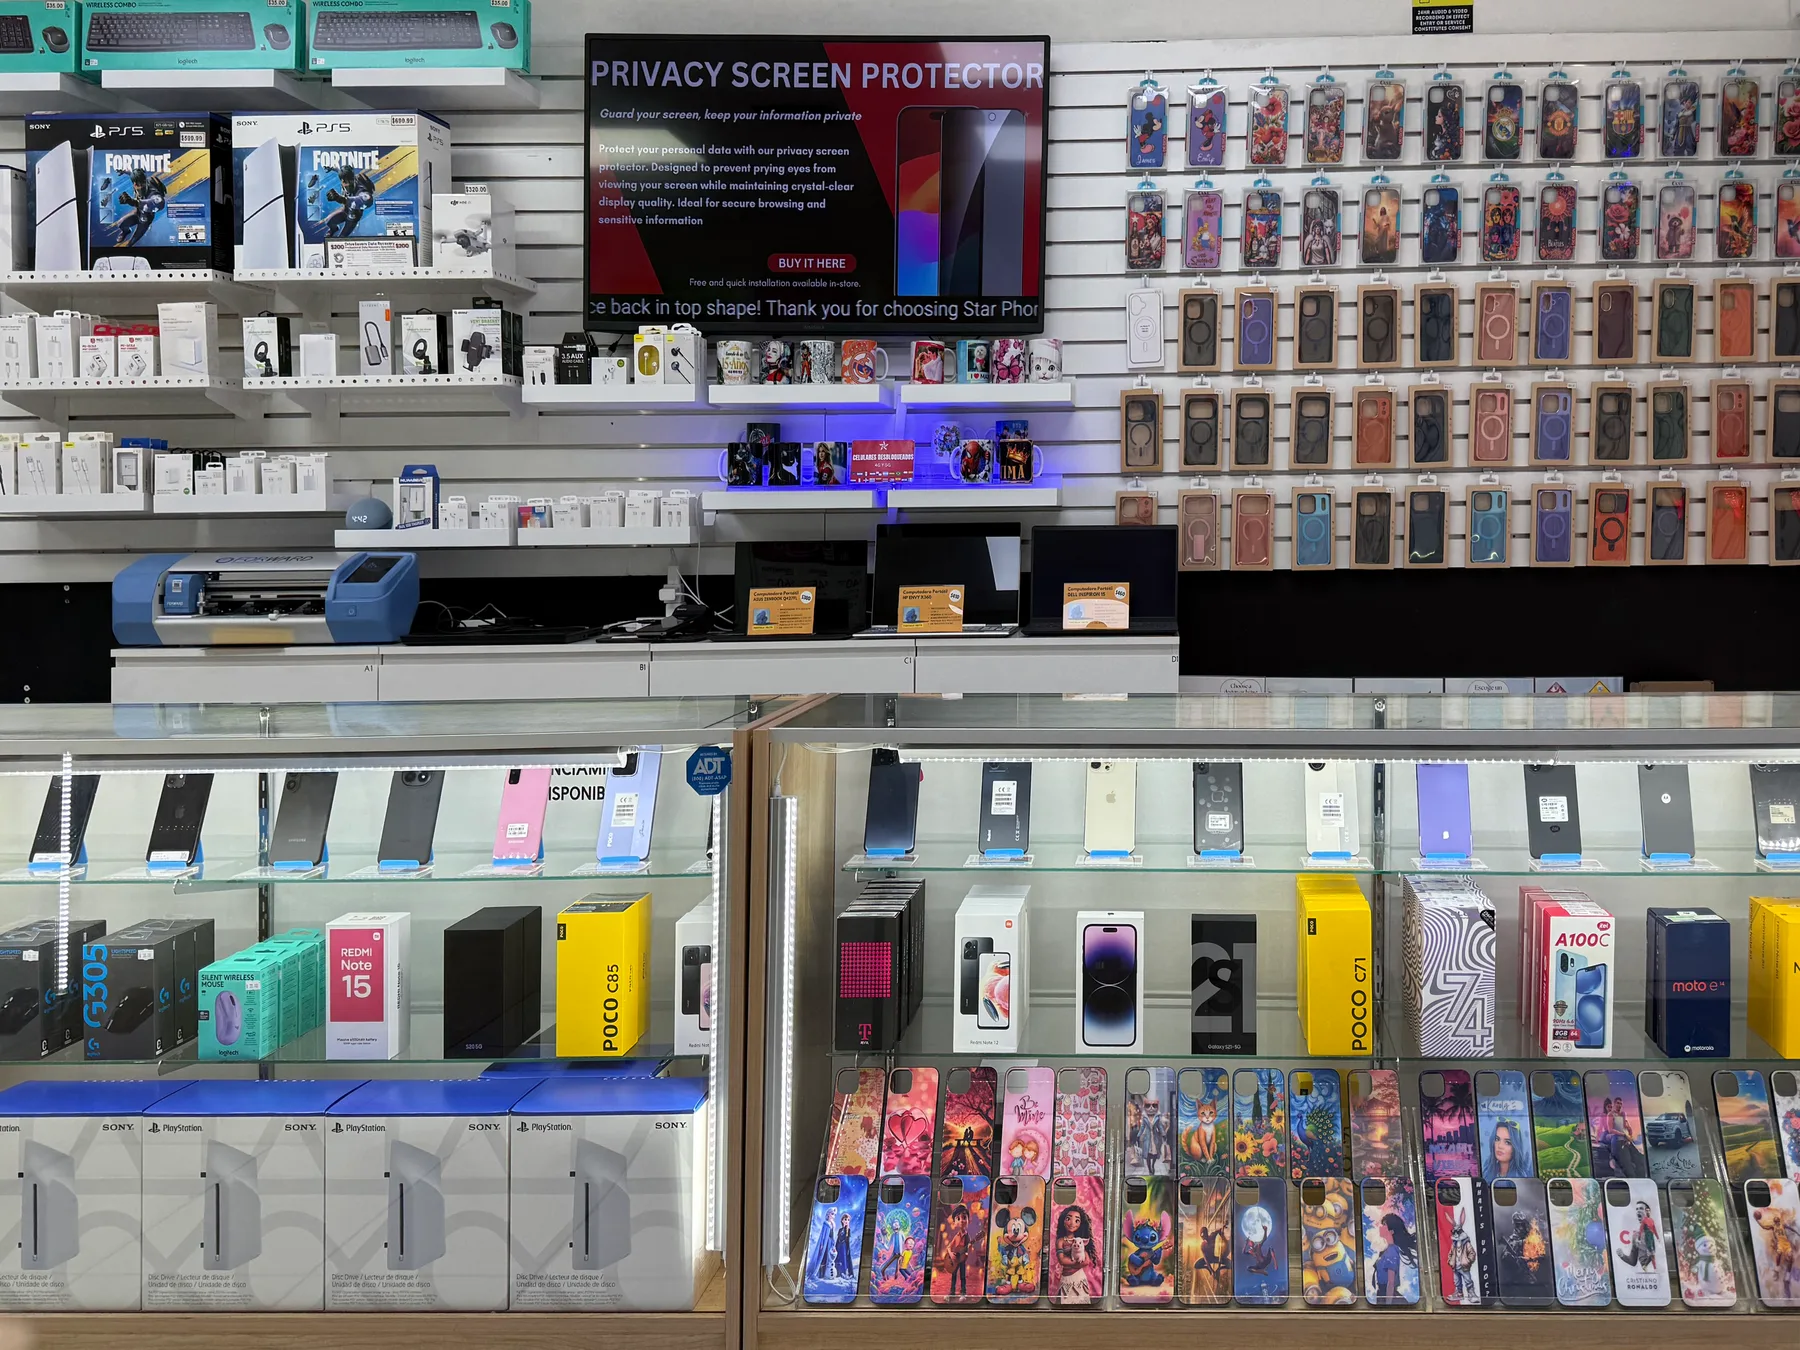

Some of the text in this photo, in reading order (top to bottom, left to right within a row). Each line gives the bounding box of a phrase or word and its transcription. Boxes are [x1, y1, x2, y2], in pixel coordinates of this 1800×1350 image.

[592, 61, 1043, 89] PRIVACY SCREEN PROTECTOR
[600, 108, 862, 123] Guard your screen, keep your information private
[109, 126, 144, 136] PS5
[316, 123, 351, 132] PS5
[599, 145, 635, 154] Protect
[638, 146, 659, 157] your
[661, 145, 706, 157] personal
[708, 146, 731, 155] data
[733, 146, 755, 155] with
[776, 147, 813, 157] privacy
[106, 153, 172, 173] FORTNITE
[313, 150, 379, 170] FORTNITE
[599, 163, 836, 175] protector. Designed to prevent prying eyes from
[598, 180, 637, 191] viewing
[640, 182, 662, 191] your
[700, 181, 727, 190] while
[730, 181, 788, 192] maintaining
[791, 182, 854, 192] crystal-clear
[598, 197, 635, 209] display
[638, 198, 674, 209] quality.
[677, 198, 703, 207] Ideal
[705, 198, 720, 207] for
[758, 199, 804, 210] browsing
[807, 200, 825, 208] and
[598, 215, 703, 225] sensitive information
[779, 258, 845, 268] BUY IT HERE
[690, 278, 861, 288] Free and quick installation available in-store.
[611, 298, 996, 319] back in top shape! Thank you for choosing Star
[693, 757, 725, 775] ADT
[1555, 933, 1610, 947] A100C
[341, 948, 372, 957] REDMI
[341, 960, 372, 971] Note
[83, 944, 108, 1028] G305
[342, 975, 371, 998] 15
[1672, 980, 1706, 992] moto
[603, 964, 618, 1051] POCO C85
[1352, 958, 1367, 1050] POCO C71
[163, 1124, 202, 1133] PlayStation
[346, 1124, 386, 1133] PlayStation
[531, 1123, 572, 1132] PlayStation
[1482, 1240, 1486, 1254] UP
[1566, 1264, 1602, 1284] Merry
[1558, 1278, 1608, 1296] Christmas
